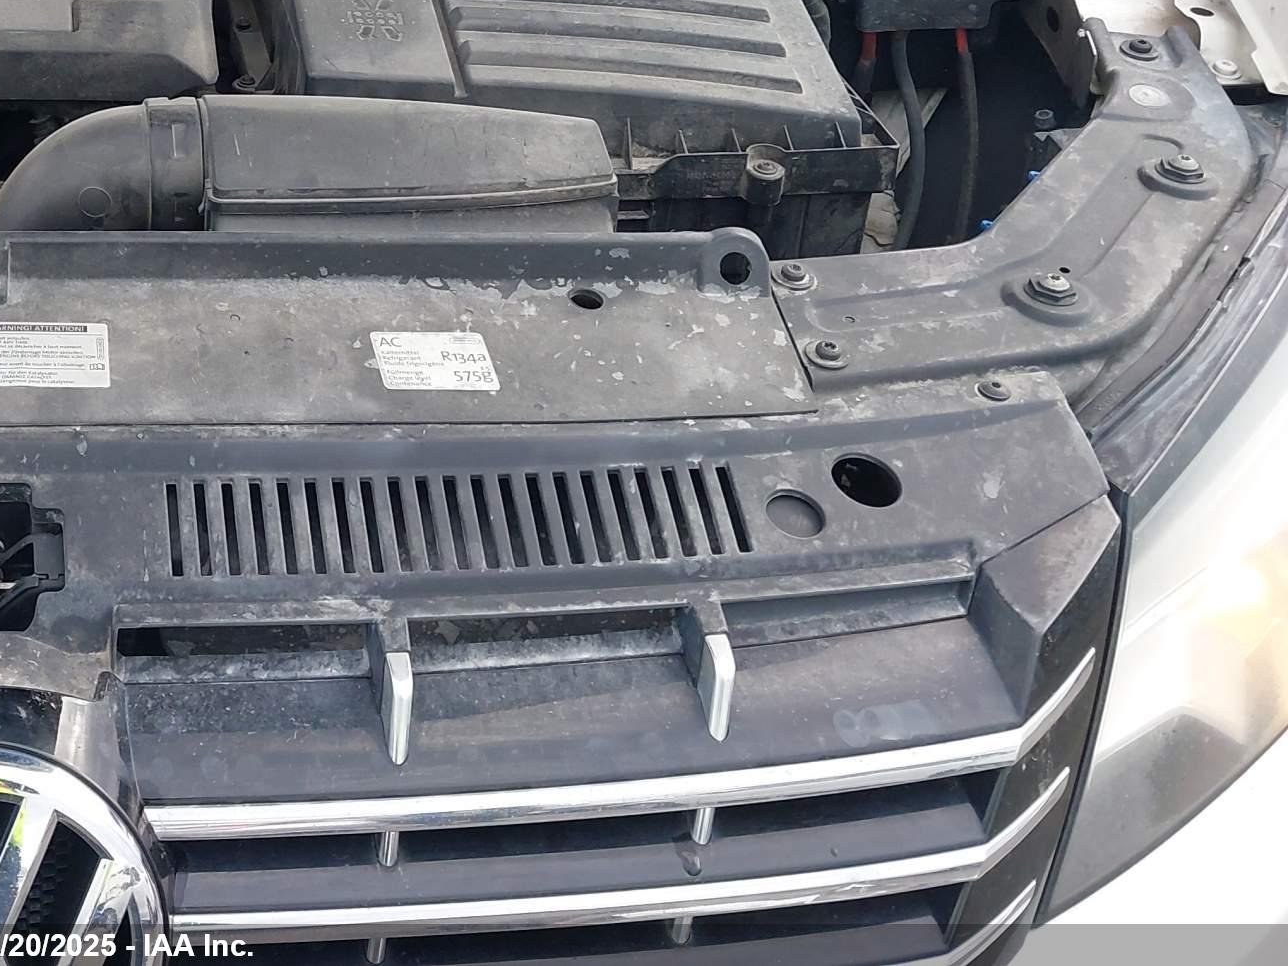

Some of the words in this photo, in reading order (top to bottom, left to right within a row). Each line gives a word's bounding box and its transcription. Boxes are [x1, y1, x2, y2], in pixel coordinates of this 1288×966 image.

[380, 336, 402, 347] AC
[440, 350, 487, 364] R134a
[453, 370, 494, 384] 575g
